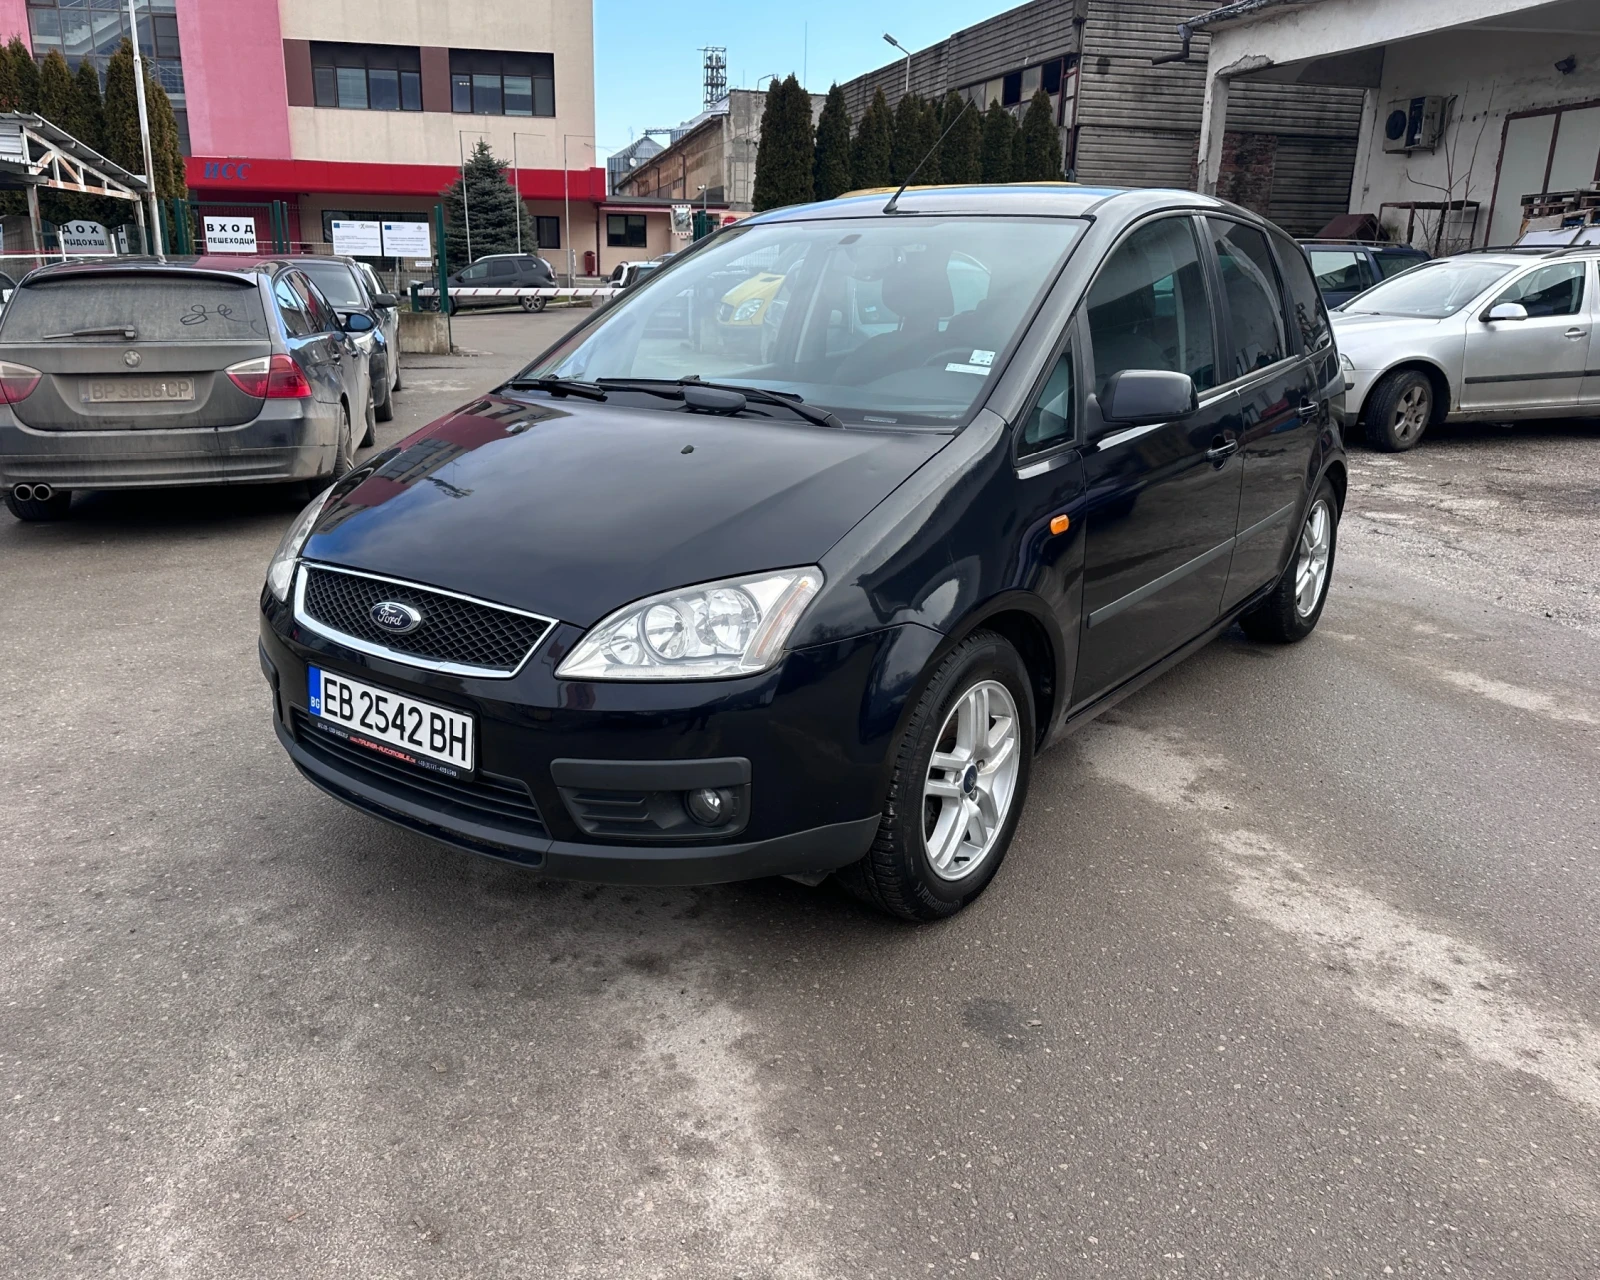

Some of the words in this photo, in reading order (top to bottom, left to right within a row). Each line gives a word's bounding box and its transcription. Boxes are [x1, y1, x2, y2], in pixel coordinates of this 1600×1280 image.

[203, 161, 251, 180] ИСС
[206, 223, 254, 235] ВХОД
[208, 237, 255, 246] ПЕШЕХОДЦИ
[377, 603, 403, 625] Ford
[310, 696, 320, 709] BG
[324, 677, 354, 722] EB
[360, 690, 423, 747] 2542
[430, 713, 467, 762] BH
